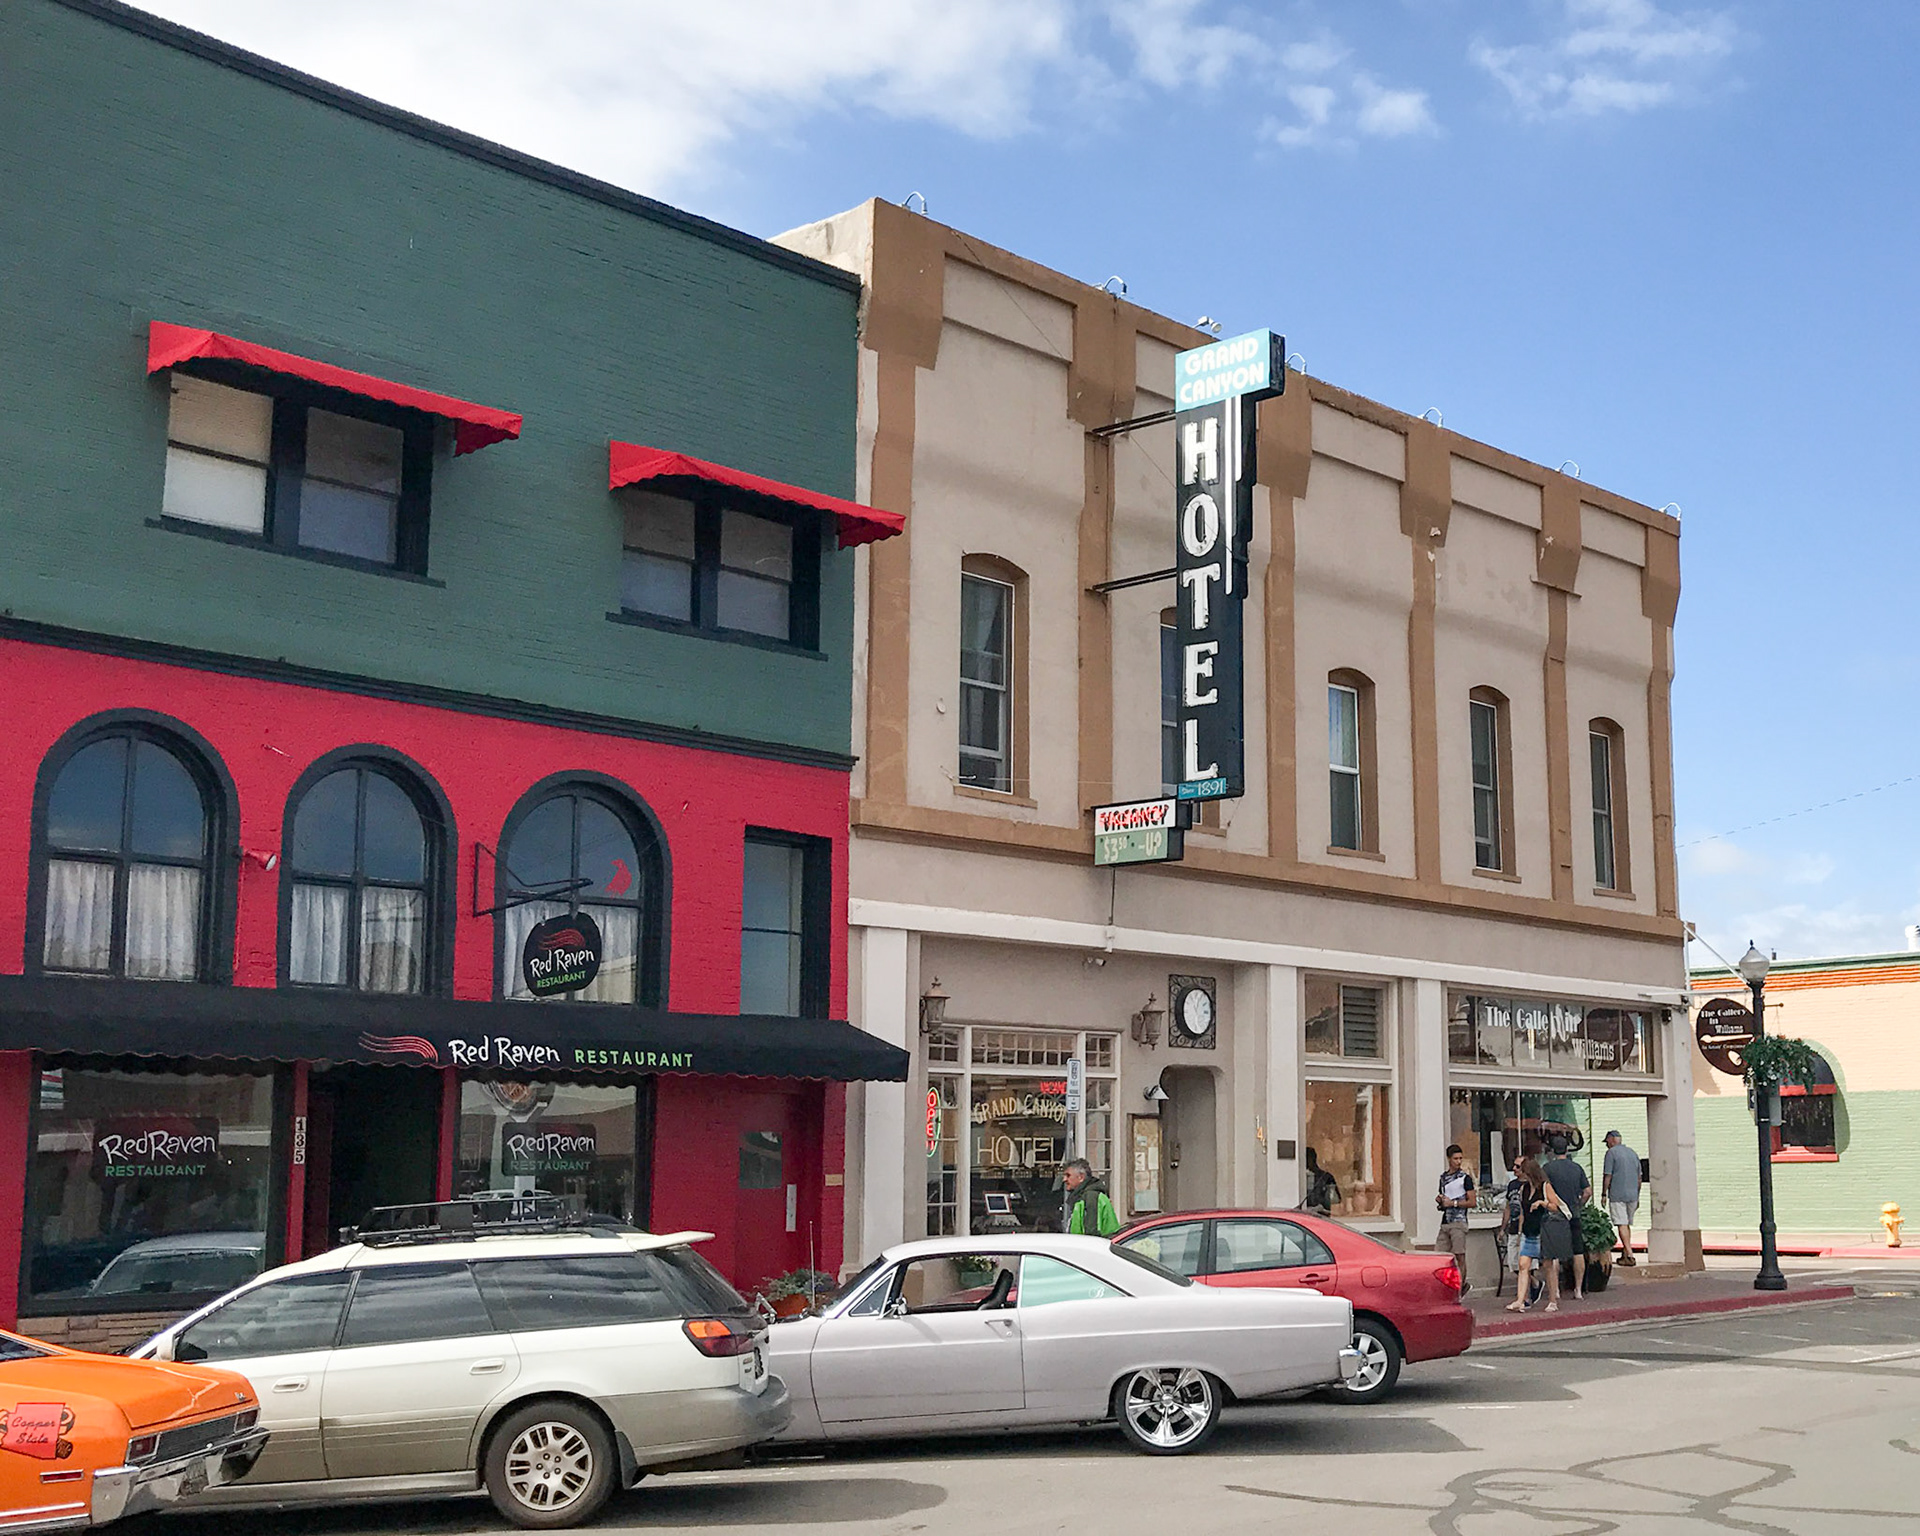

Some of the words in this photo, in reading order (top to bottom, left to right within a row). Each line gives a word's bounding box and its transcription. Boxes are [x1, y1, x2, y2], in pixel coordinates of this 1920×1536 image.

[1184, 337, 1259, 375] GRAND
[1180, 361, 1264, 403] CANYON
[1182, 415, 1221, 780] HOTEL
[1198, 780, 1224, 796] 1891
[1100, 804, 1169, 832] VACANCY
[529, 949, 552, 978] Red
[553, 948, 595, 972] Raven
[536, 970, 587, 988] RESTAURANT
[1485, 1006, 1512, 1028] The
[1701, 1010, 1716, 1018] The
[1717, 1008, 1747, 1018] Gallery
[1715, 1025, 1744, 1034] Williams
[448, 1035, 489, 1065] Red
[494, 1036, 561, 1067] Raven
[574, 1048, 694, 1068] RESTAURANT
[974, 1096, 1017, 1125] GRAND
[977, 1135, 1063, 1165] HOTEL
[105, 1164, 206, 1178] RESTAURANT
[510, 1159, 592, 1172] RESTAURANT
[12, 1416, 55, 1431] Copper
[16, 1432, 49, 1445] State
